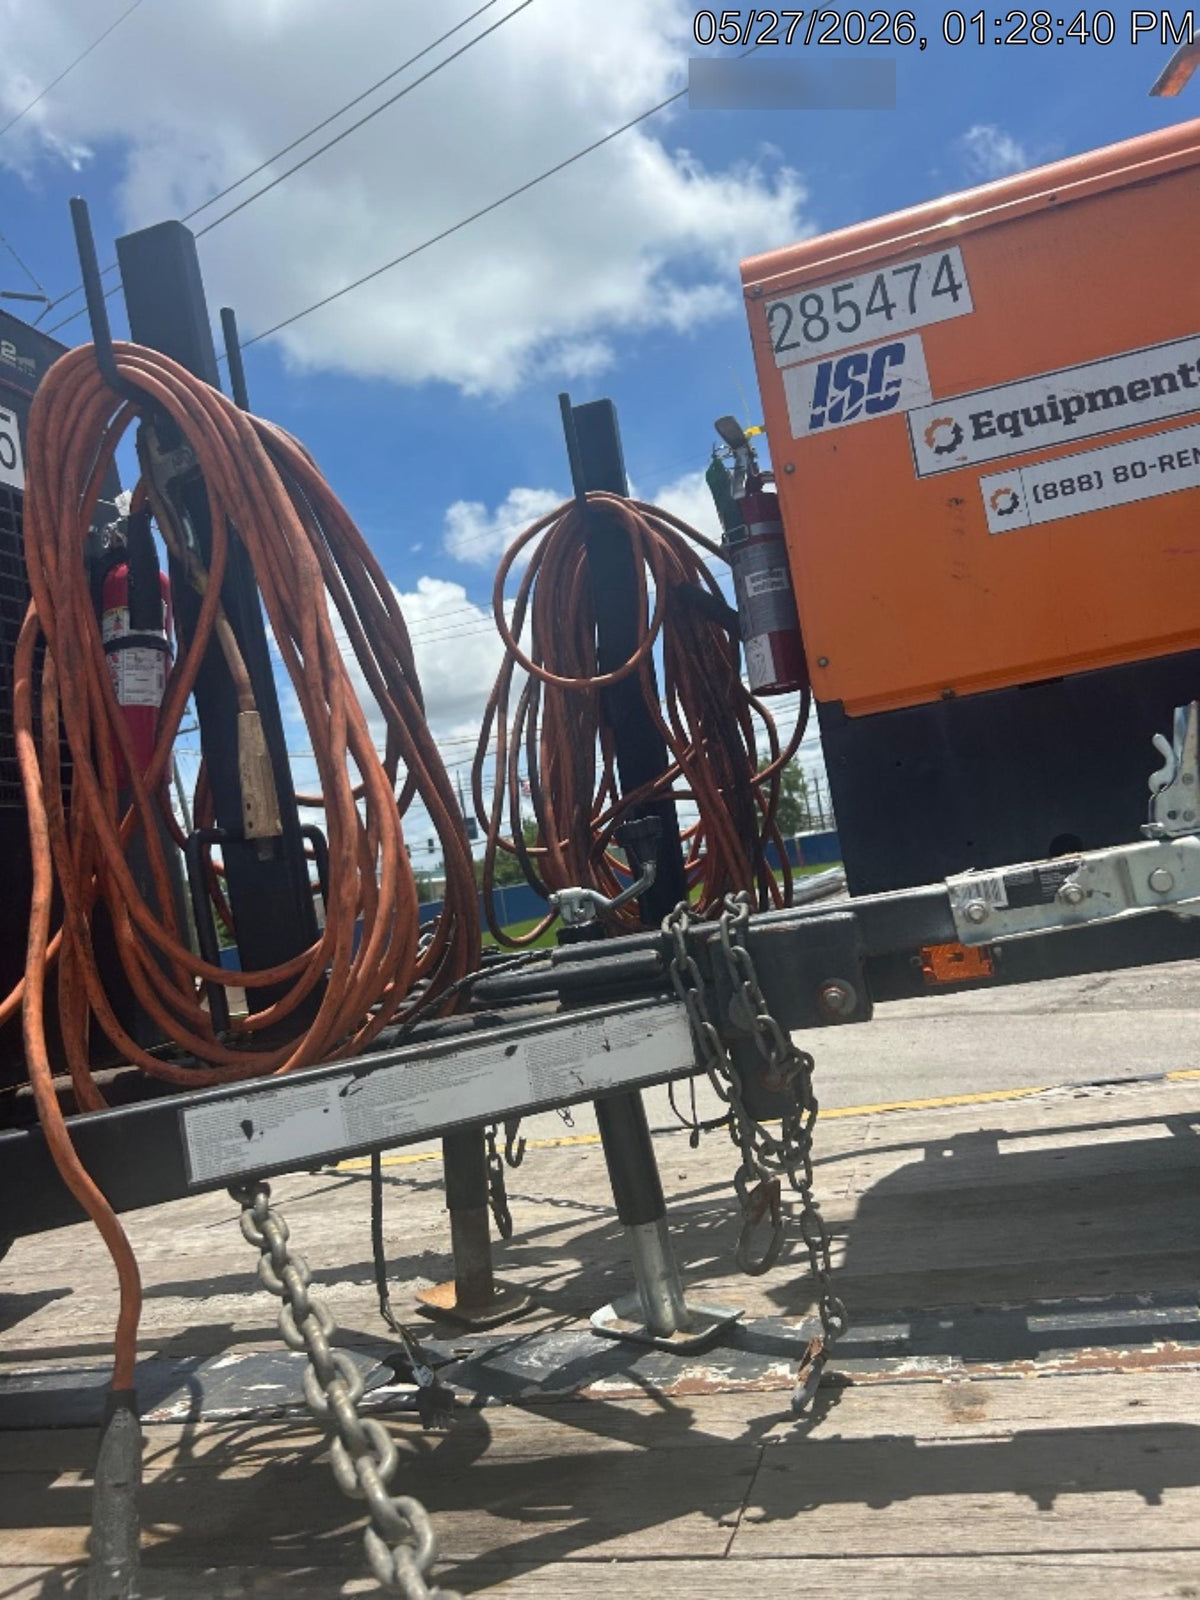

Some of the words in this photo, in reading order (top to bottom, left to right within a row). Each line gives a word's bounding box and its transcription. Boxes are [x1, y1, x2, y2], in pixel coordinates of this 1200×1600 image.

[767, 253, 963, 354] 285474
[969, 357, 1200, 442] Equipment
[1032, 470, 1104, 504] (888)
